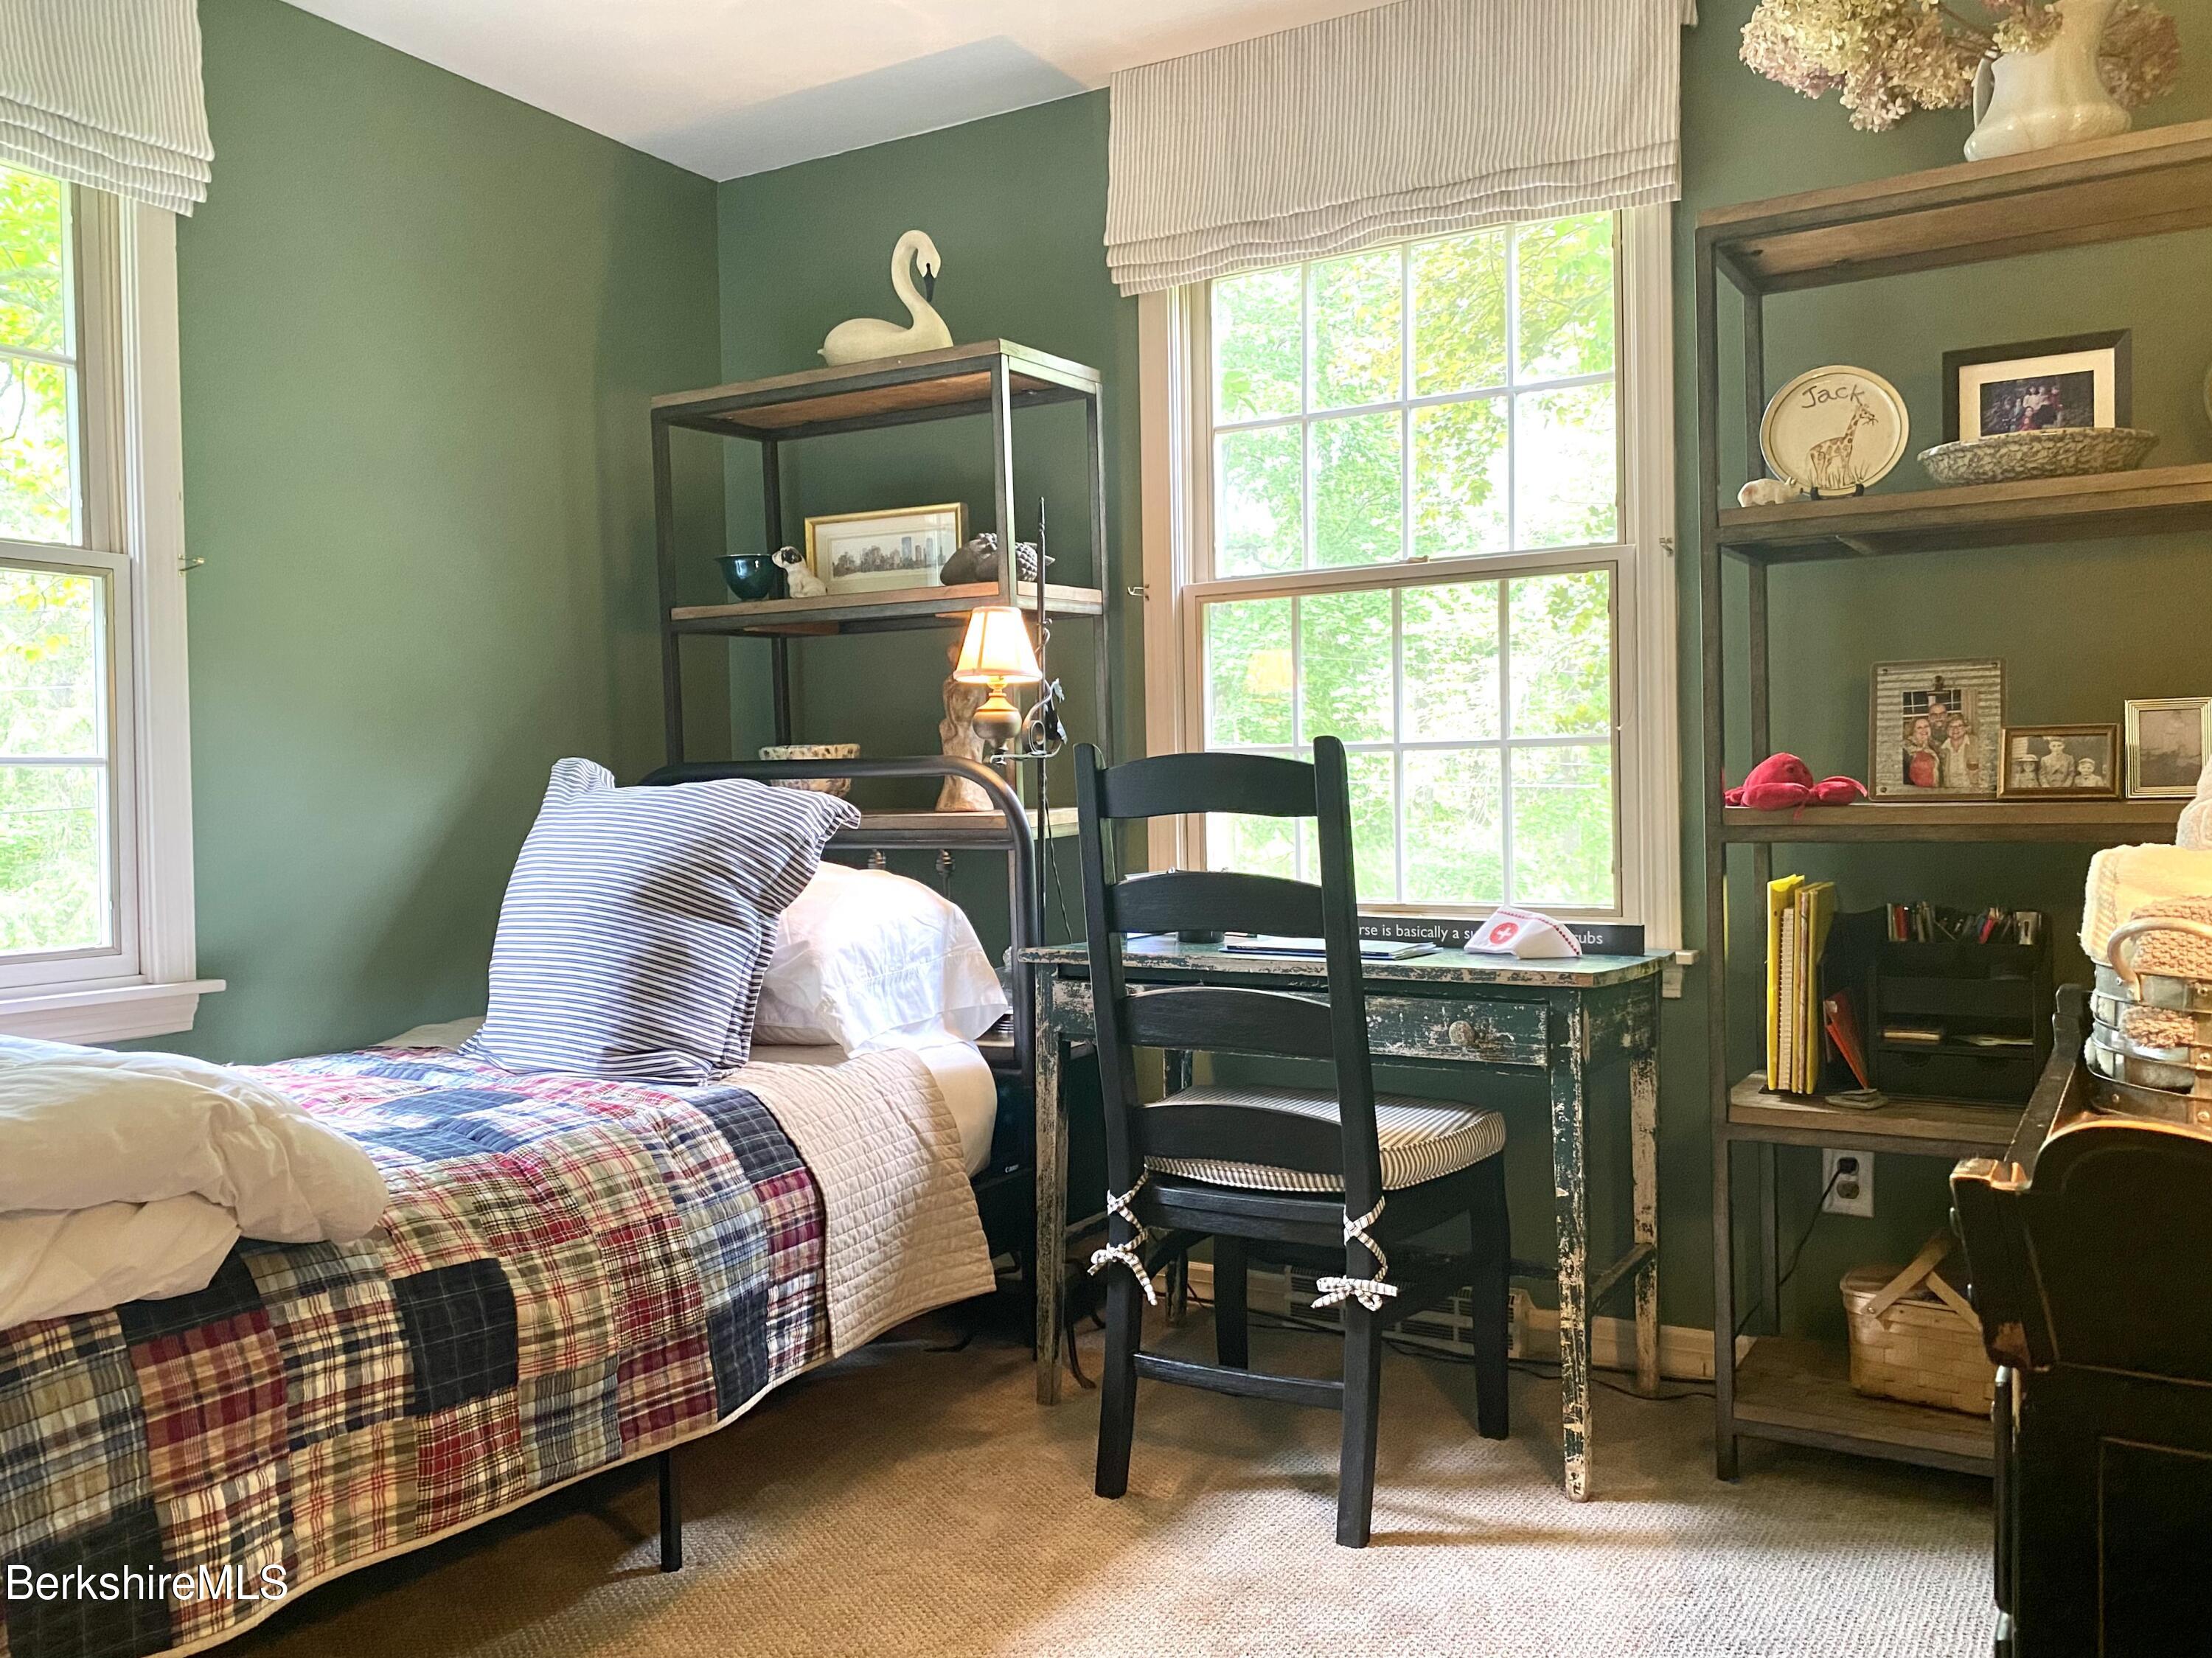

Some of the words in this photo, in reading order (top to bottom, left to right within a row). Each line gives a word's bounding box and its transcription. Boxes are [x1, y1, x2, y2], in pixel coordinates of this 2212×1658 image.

[1801, 384, 1865, 408] Jack
[1382, 924, 1392, 936] is
[1396, 924, 1449, 942] basically
[1452, 930, 1460, 939] a
